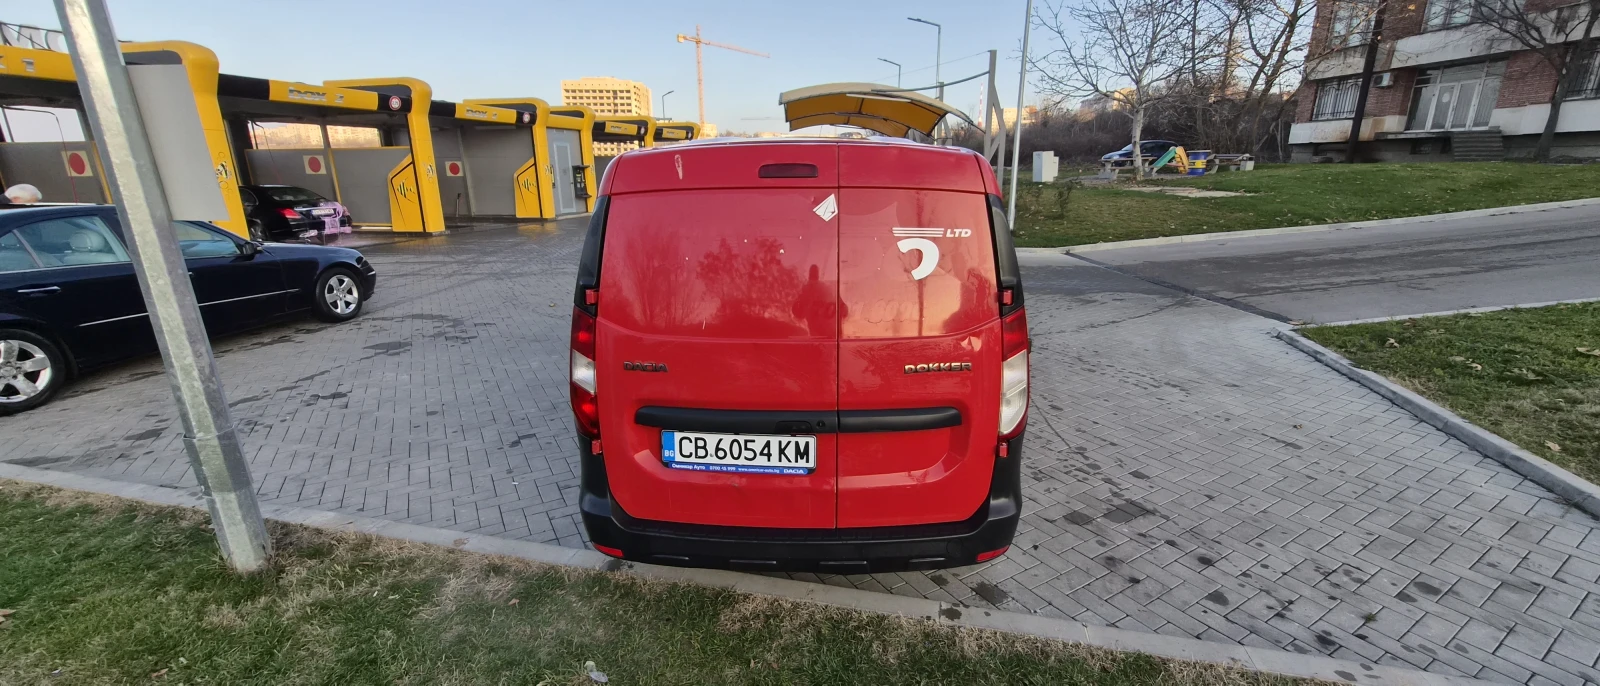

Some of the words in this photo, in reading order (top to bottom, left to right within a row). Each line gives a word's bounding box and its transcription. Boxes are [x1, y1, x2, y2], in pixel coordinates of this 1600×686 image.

[945, 228, 972, 238] LTD
[623, 361, 668, 373] DACIA
[904, 361, 973, 374] DOKKER
[664, 449, 675, 457] BG
